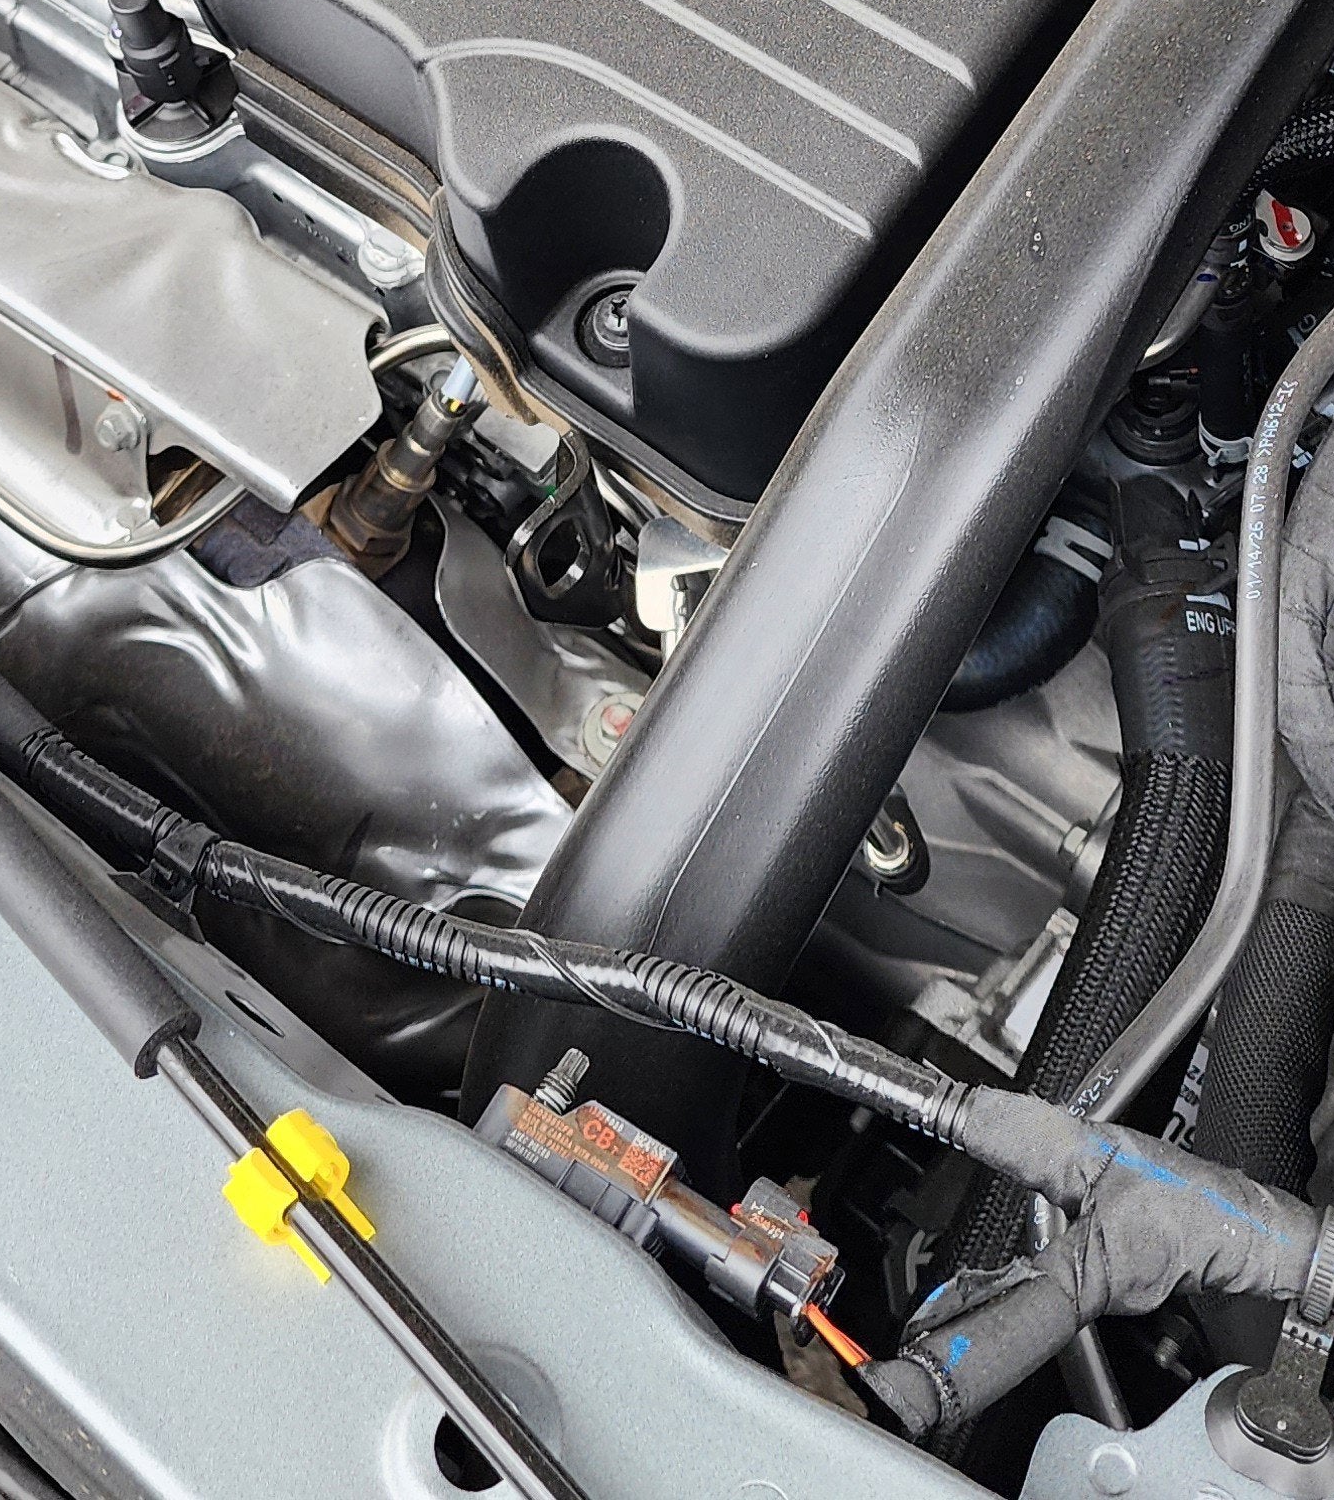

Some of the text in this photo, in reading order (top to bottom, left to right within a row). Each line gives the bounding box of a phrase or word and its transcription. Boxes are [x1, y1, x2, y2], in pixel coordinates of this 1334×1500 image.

[1245, 520, 1264, 600] 01/14/26
[1185, 610, 1216, 634] ENG
[583, 1118, 616, 1150] CB
